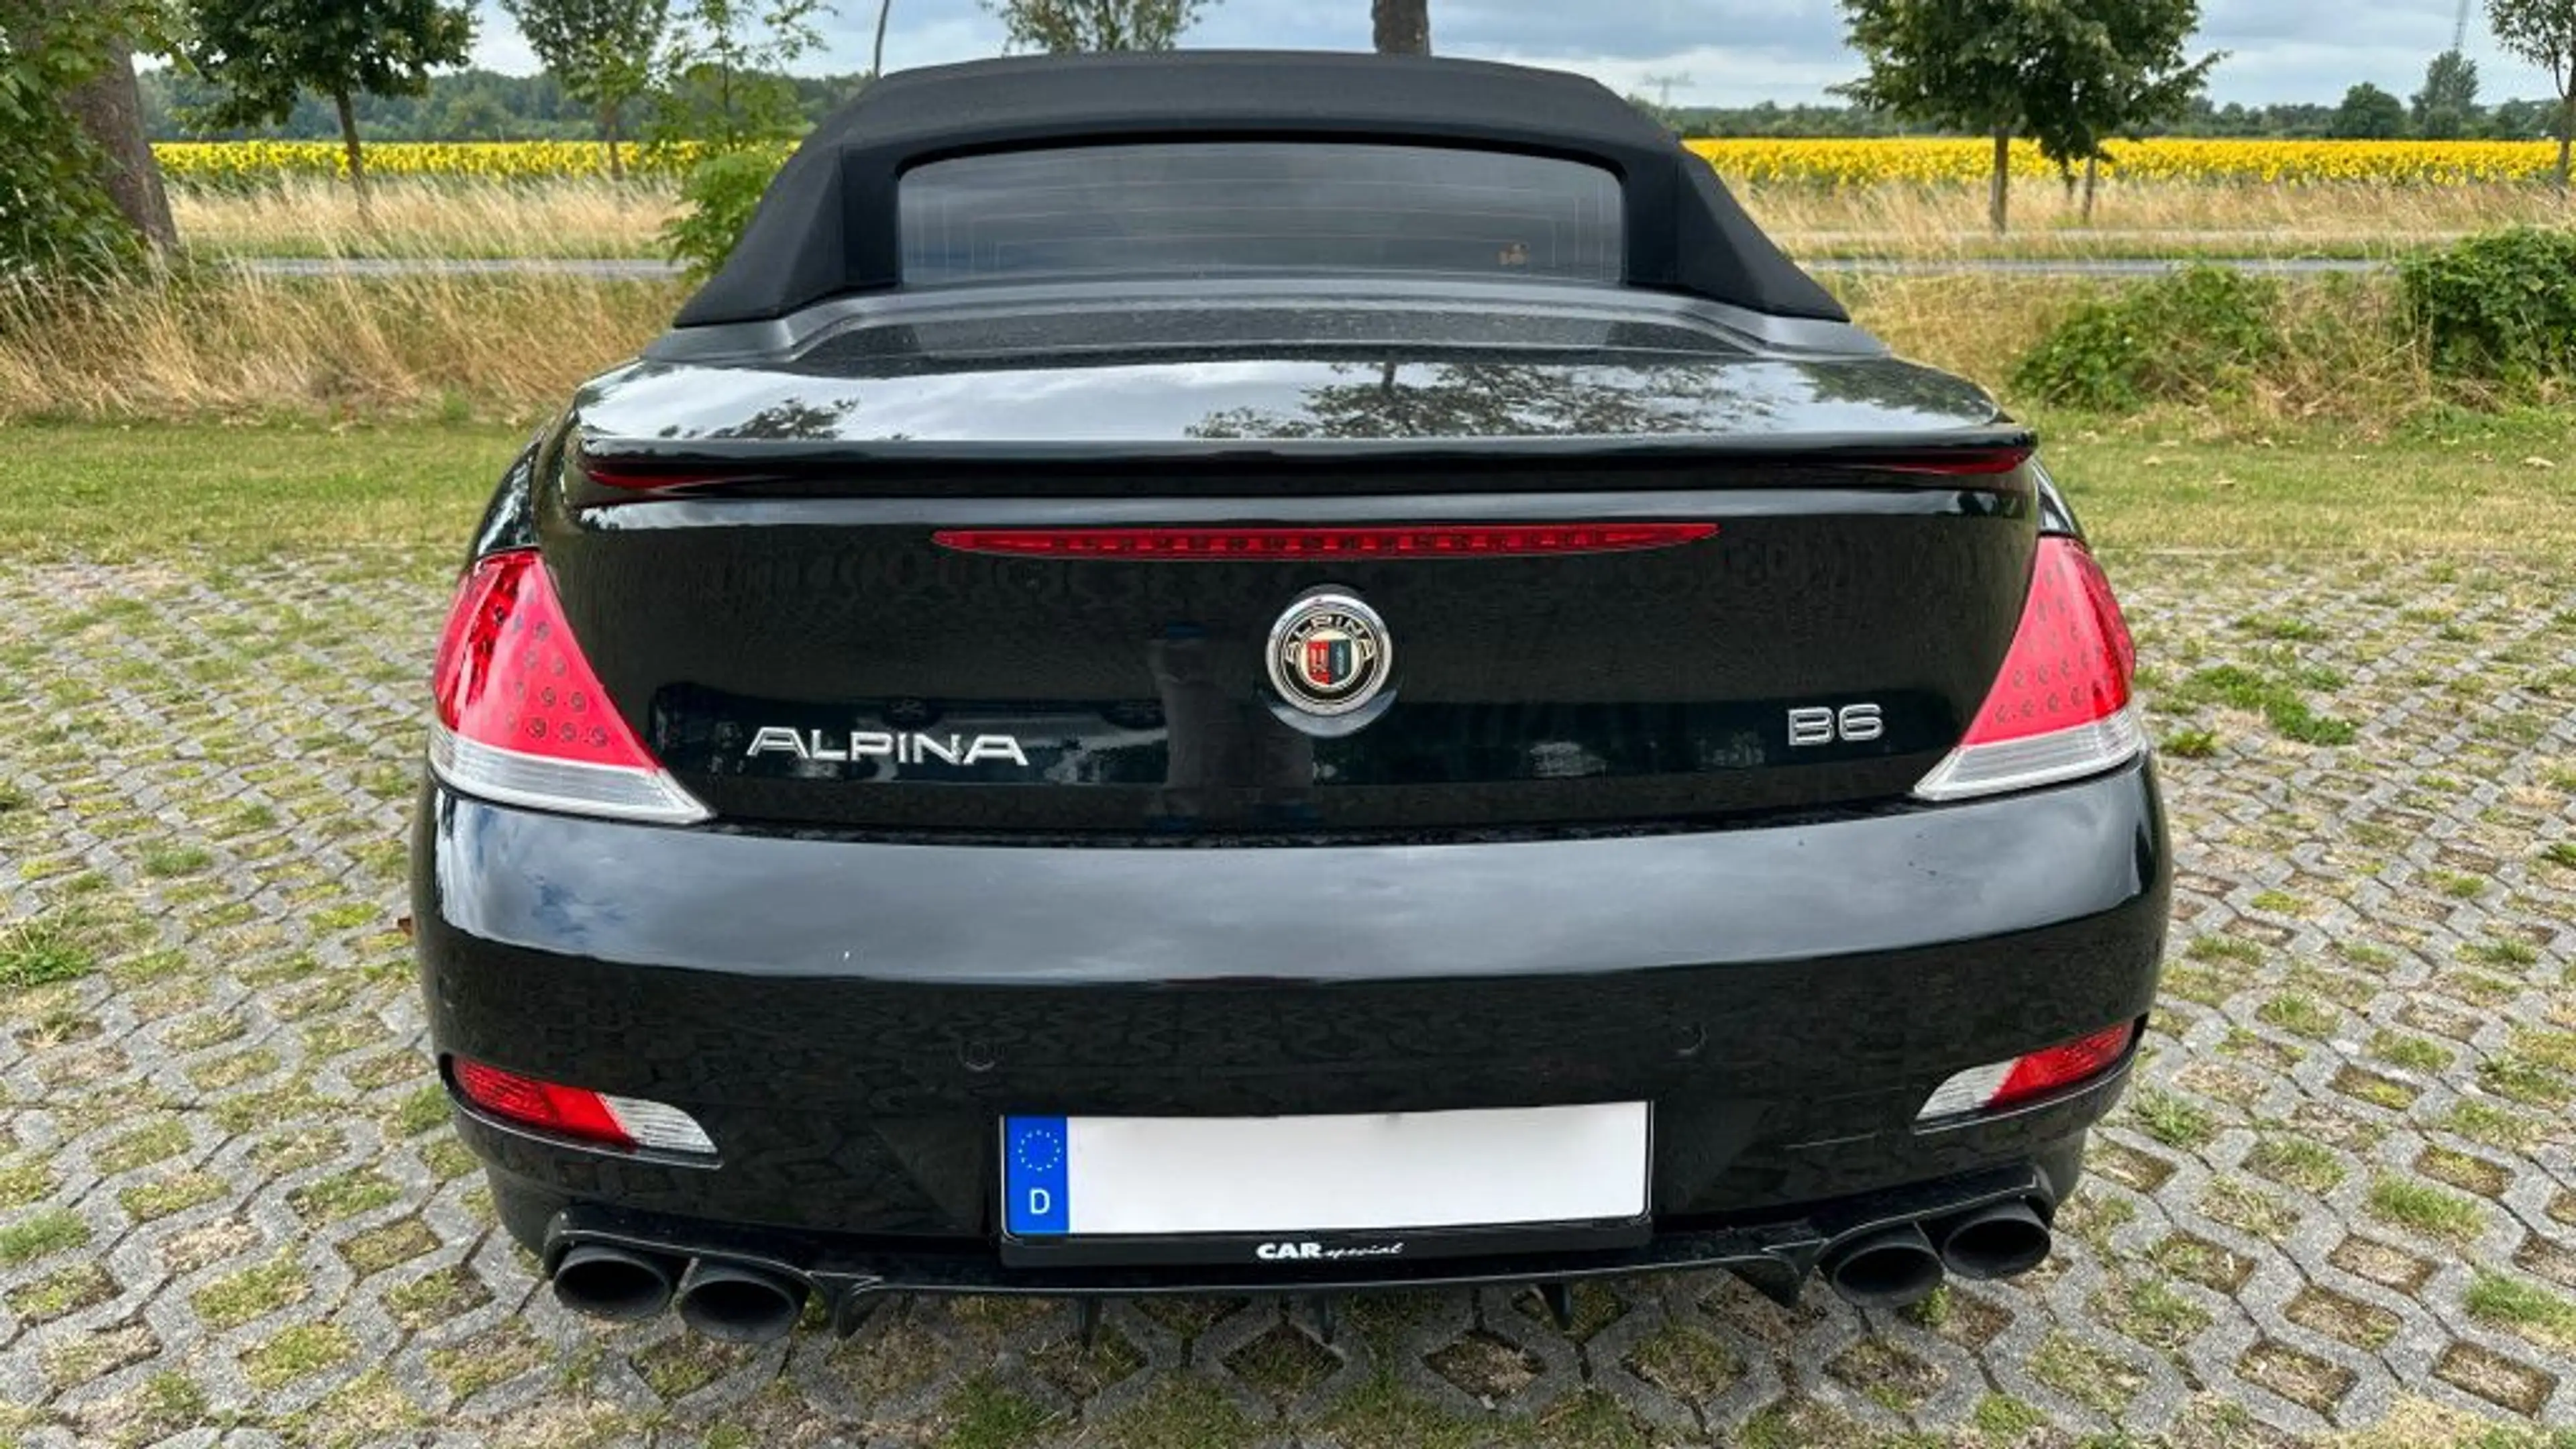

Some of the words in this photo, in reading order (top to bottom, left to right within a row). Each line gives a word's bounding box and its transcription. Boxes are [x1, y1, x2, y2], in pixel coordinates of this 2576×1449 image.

[1285, 615, 1376, 663] ALPINA
[1788, 704, 1883, 746] B6
[747, 727, 1028, 765] ALPINA
[1030, 1189, 1051, 1214] D
[1256, 1242, 1322, 1258] CAR
